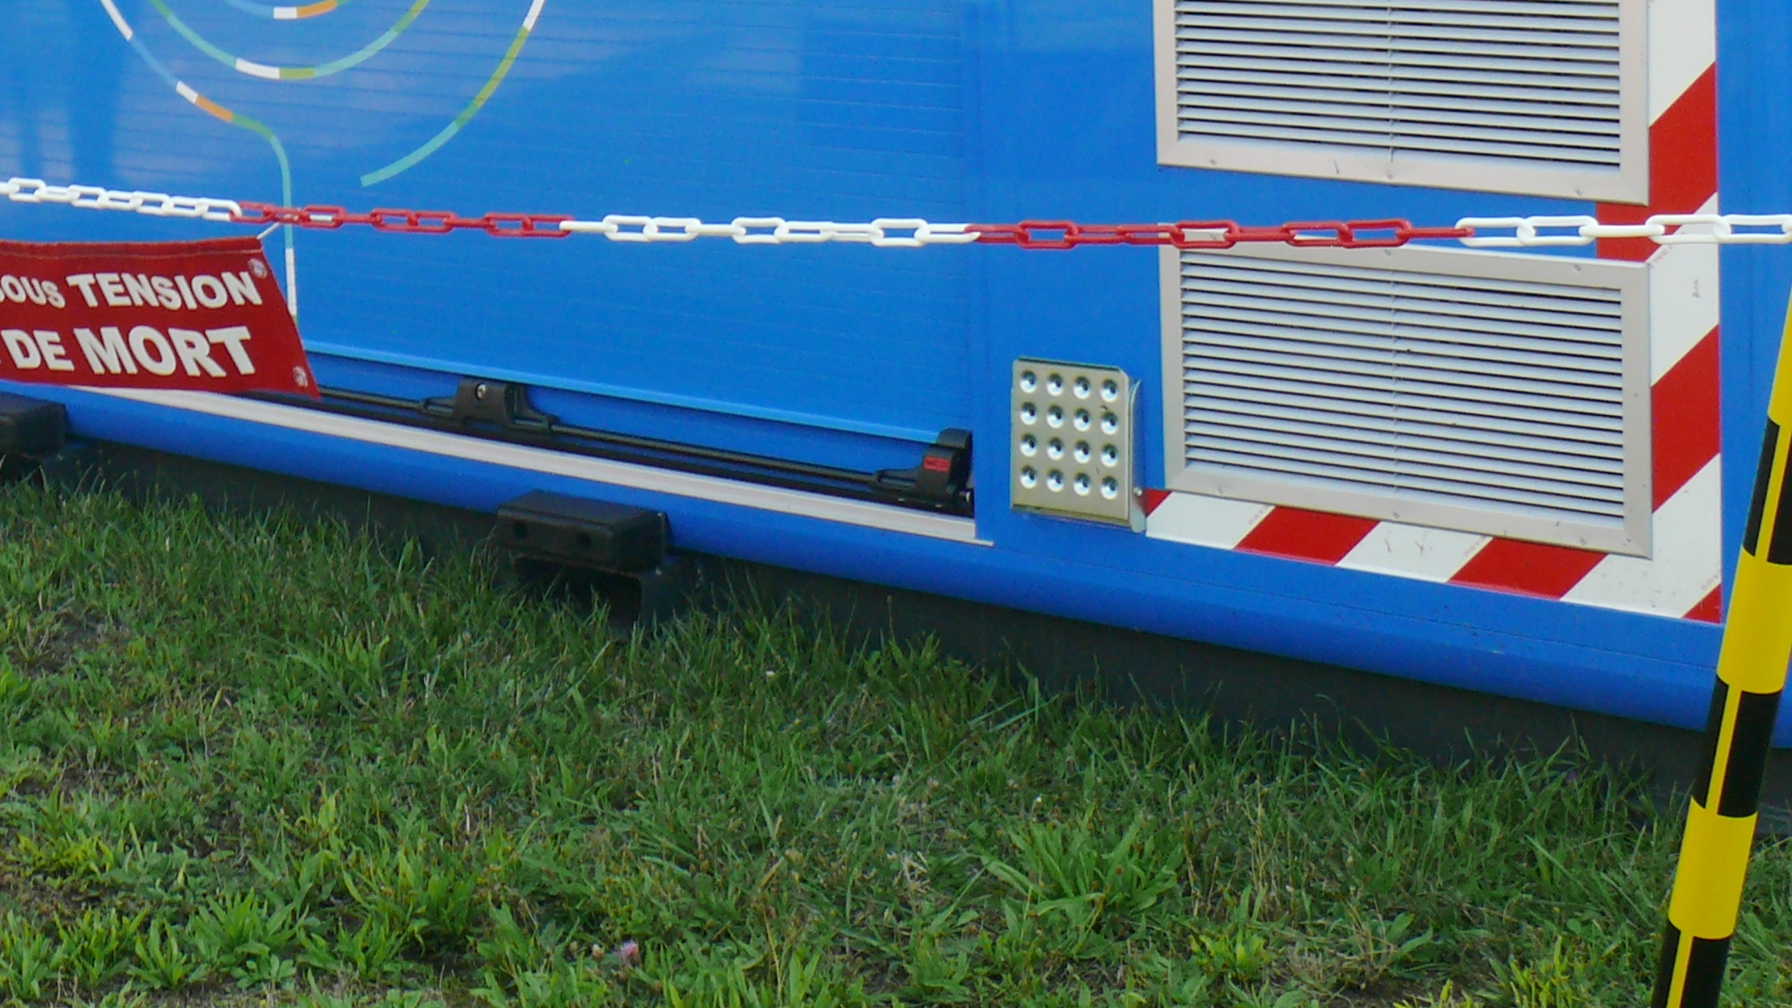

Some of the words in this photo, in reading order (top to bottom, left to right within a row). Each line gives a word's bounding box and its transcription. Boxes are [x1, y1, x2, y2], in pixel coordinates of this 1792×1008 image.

[65, 270, 264, 311] TENSION
[0, 328, 76, 373] DE
[72, 324, 258, 378] MORT
